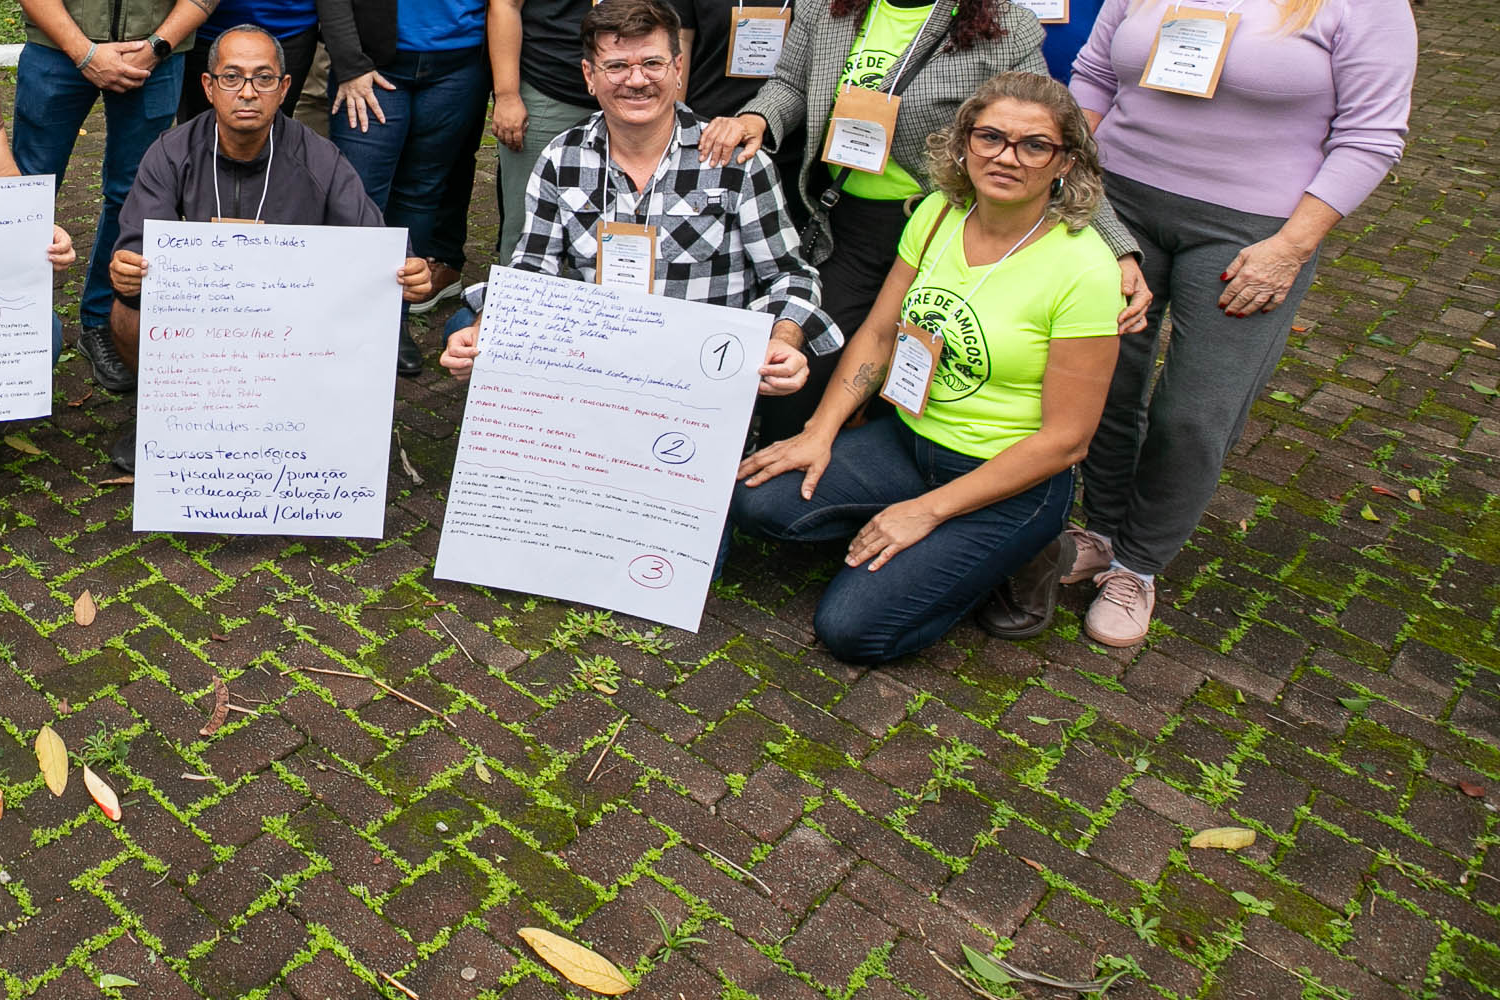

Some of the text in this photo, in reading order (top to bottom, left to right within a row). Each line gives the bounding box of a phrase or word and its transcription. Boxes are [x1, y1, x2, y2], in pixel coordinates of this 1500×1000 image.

[866, 56, 886, 69] DE
[933, 294, 954, 311] DE
[149, 326, 195, 342] COMO
[953, 308, 983, 366] AMIGOS
[713, 340, 731, 372] 1
[263, 421, 306, 432] 2030
[660, 439, 685, 458] 2
[642, 559, 665, 580] 3
